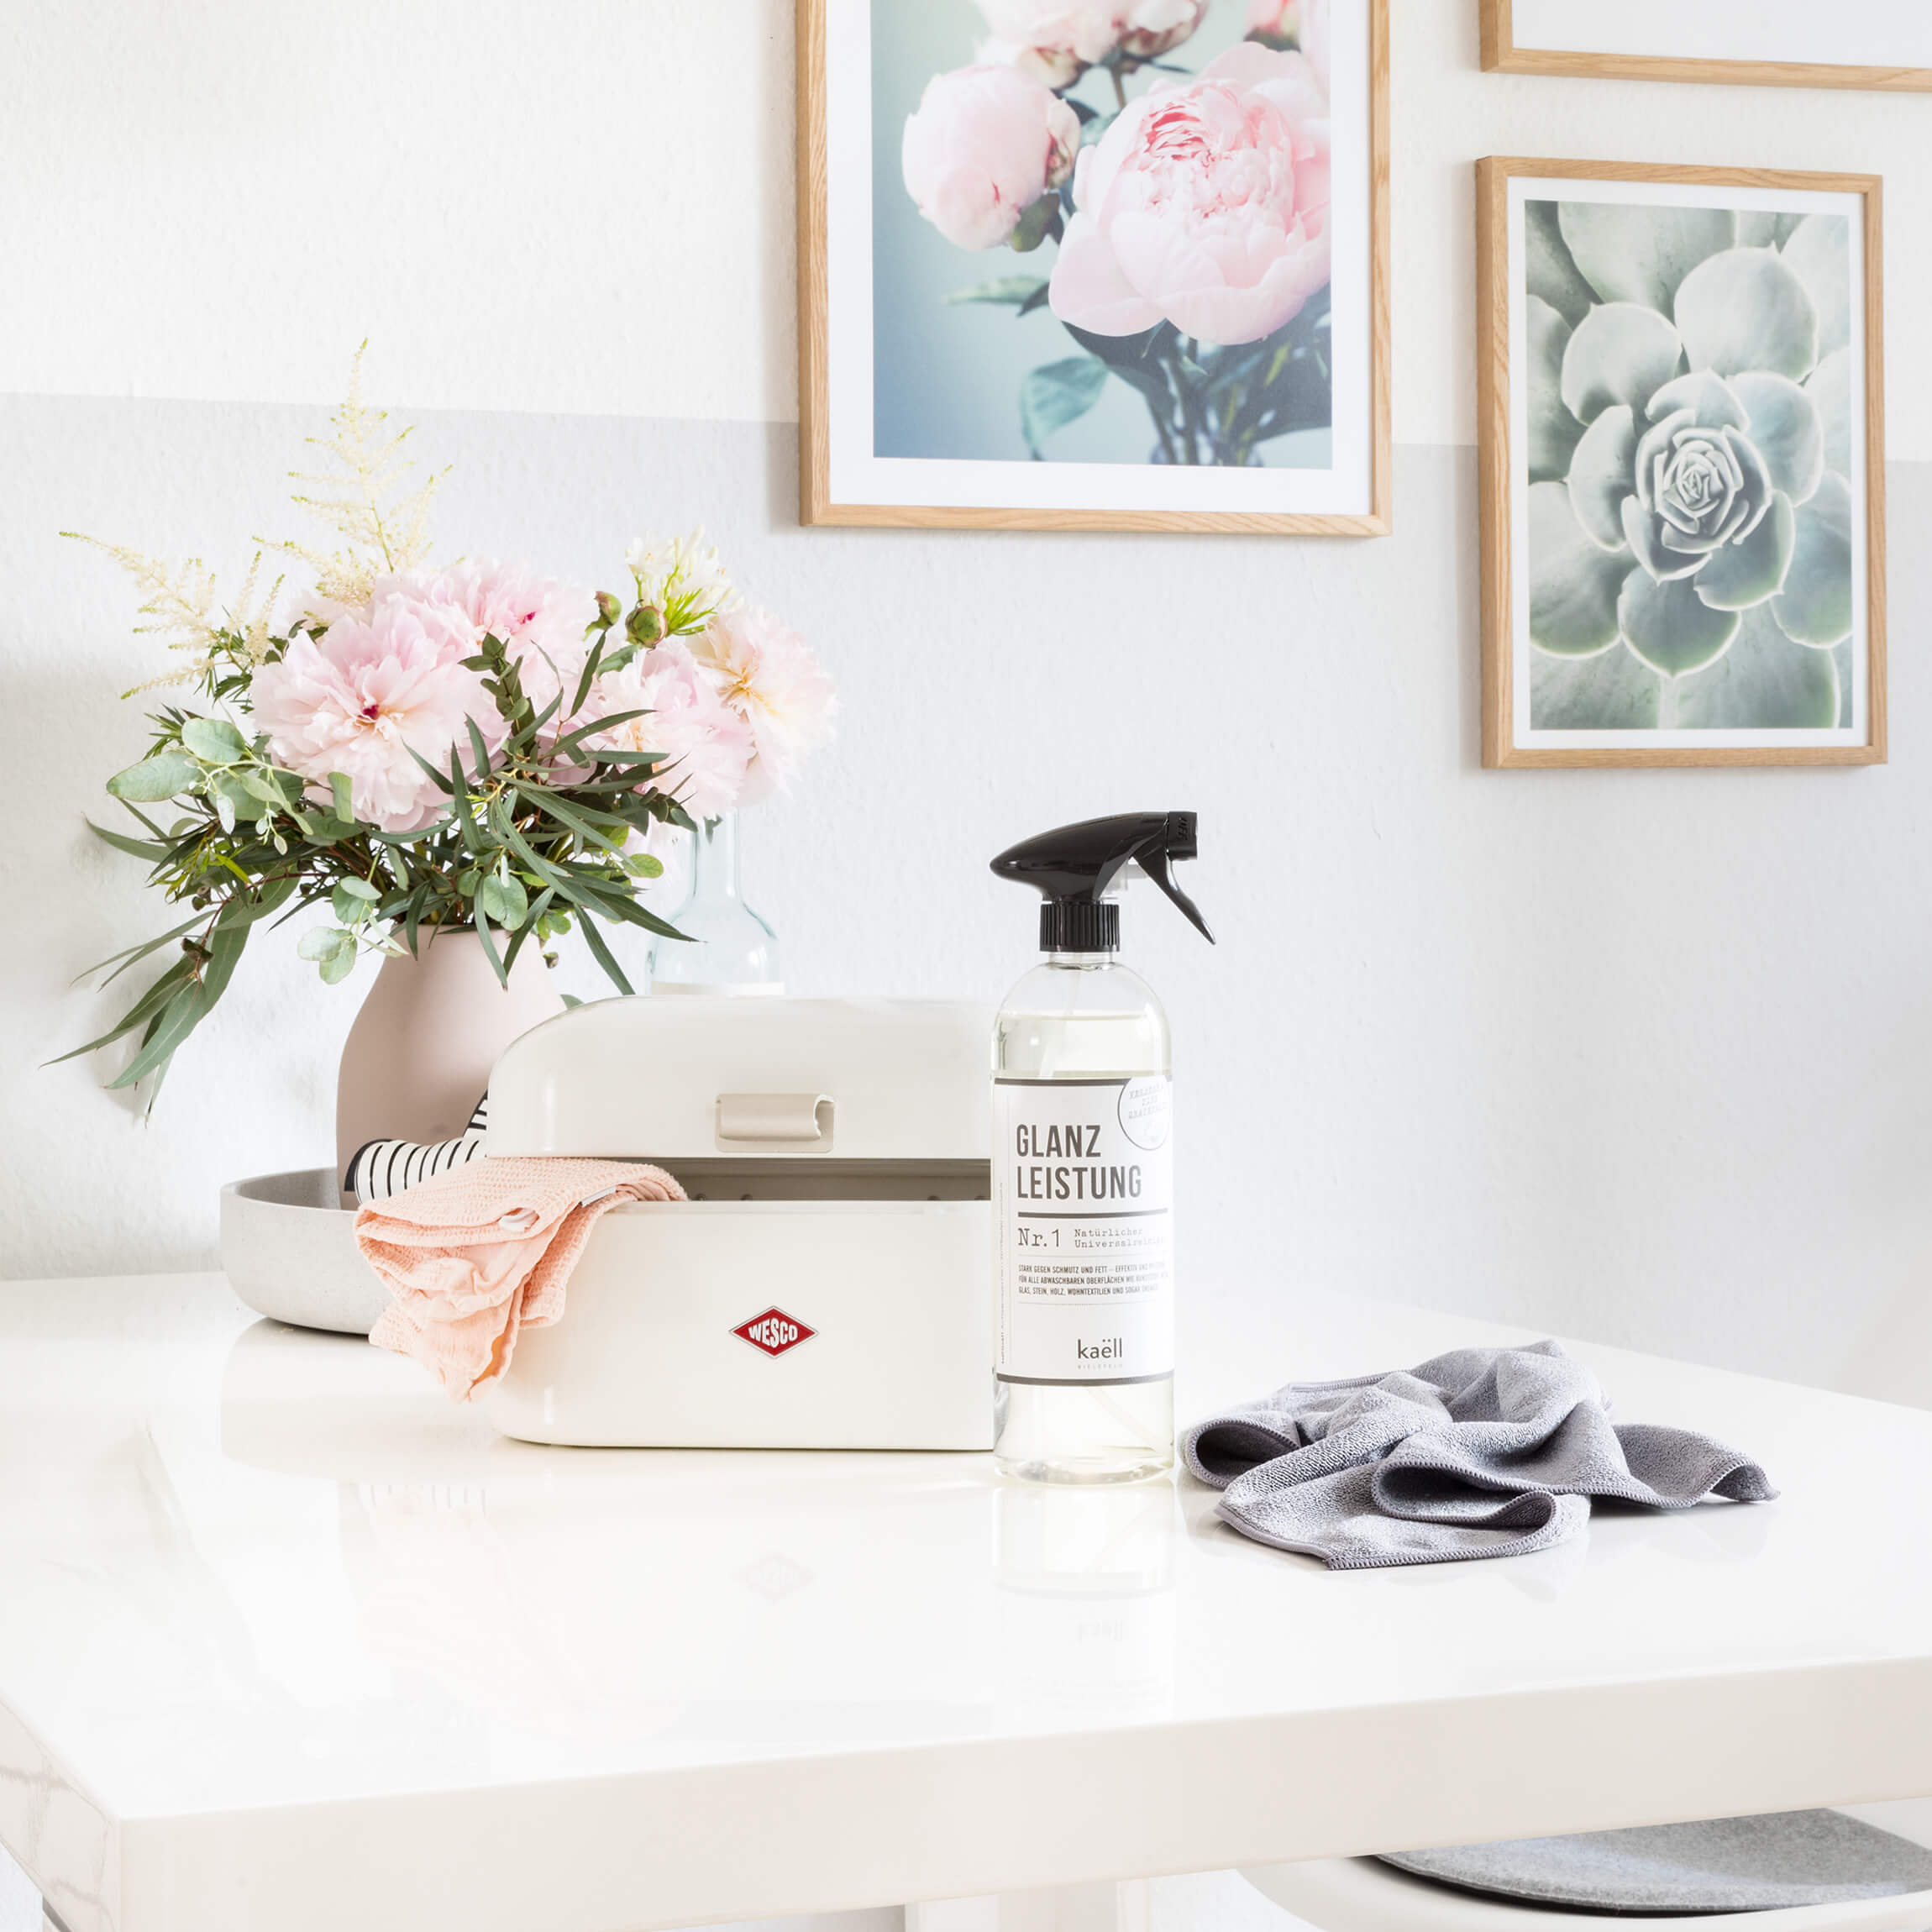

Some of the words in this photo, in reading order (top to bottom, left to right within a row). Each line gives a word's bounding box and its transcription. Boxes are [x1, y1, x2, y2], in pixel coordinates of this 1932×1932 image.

[1016, 1124, 1100, 1158] GLANZ
[1017, 1165, 1141, 1200] LEISTUNG
[1074, 1227, 1142, 1237] Natürlicher
[1086, 1275, 1124, 1284] OBERFLÄCHEN
[1126, 1285, 1140, 1294] SOGAR
[748, 1317, 798, 1348] WESCO
[1078, 1337, 1122, 1359] kaëll
